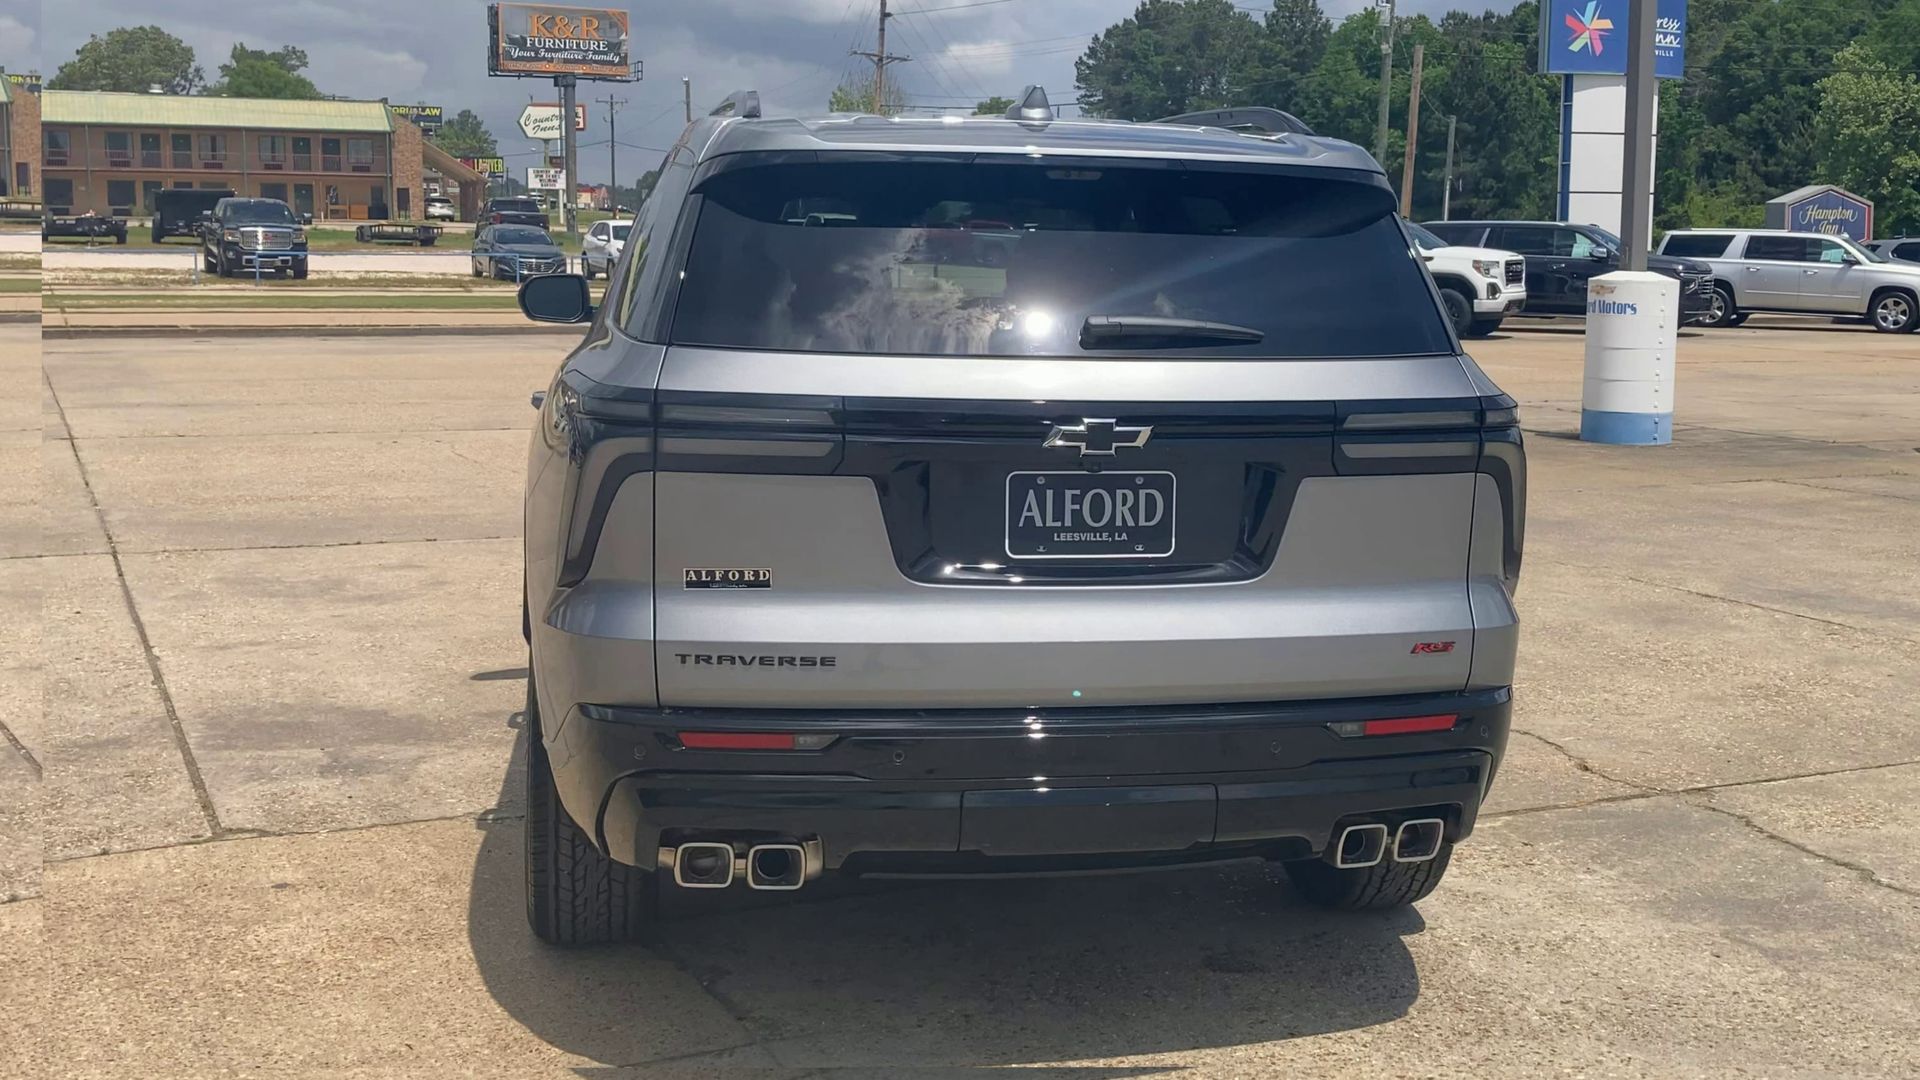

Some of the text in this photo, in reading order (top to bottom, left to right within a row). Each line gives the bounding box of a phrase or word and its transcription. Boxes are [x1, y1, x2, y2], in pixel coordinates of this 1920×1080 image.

[530, 14, 602, 38] K&R
[526, 37, 608, 51] FURNITURE
[537, 49, 585, 60] Furniture
[419, 107, 441, 116] LAW
[524, 113, 563, 127] Countr
[1799, 204, 1858, 225] Hampton
[1815, 221, 1841, 234] Inn
[1598, 299, 1637, 315] Motors
[1018, 488, 1165, 528] ALFORD
[1053, 532, 1128, 543] LEESVILLE, LA
[687, 570, 770, 581] ALFORD
[1410, 641, 1456, 655] RS
[674, 653, 837, 667] TRAVERSE
